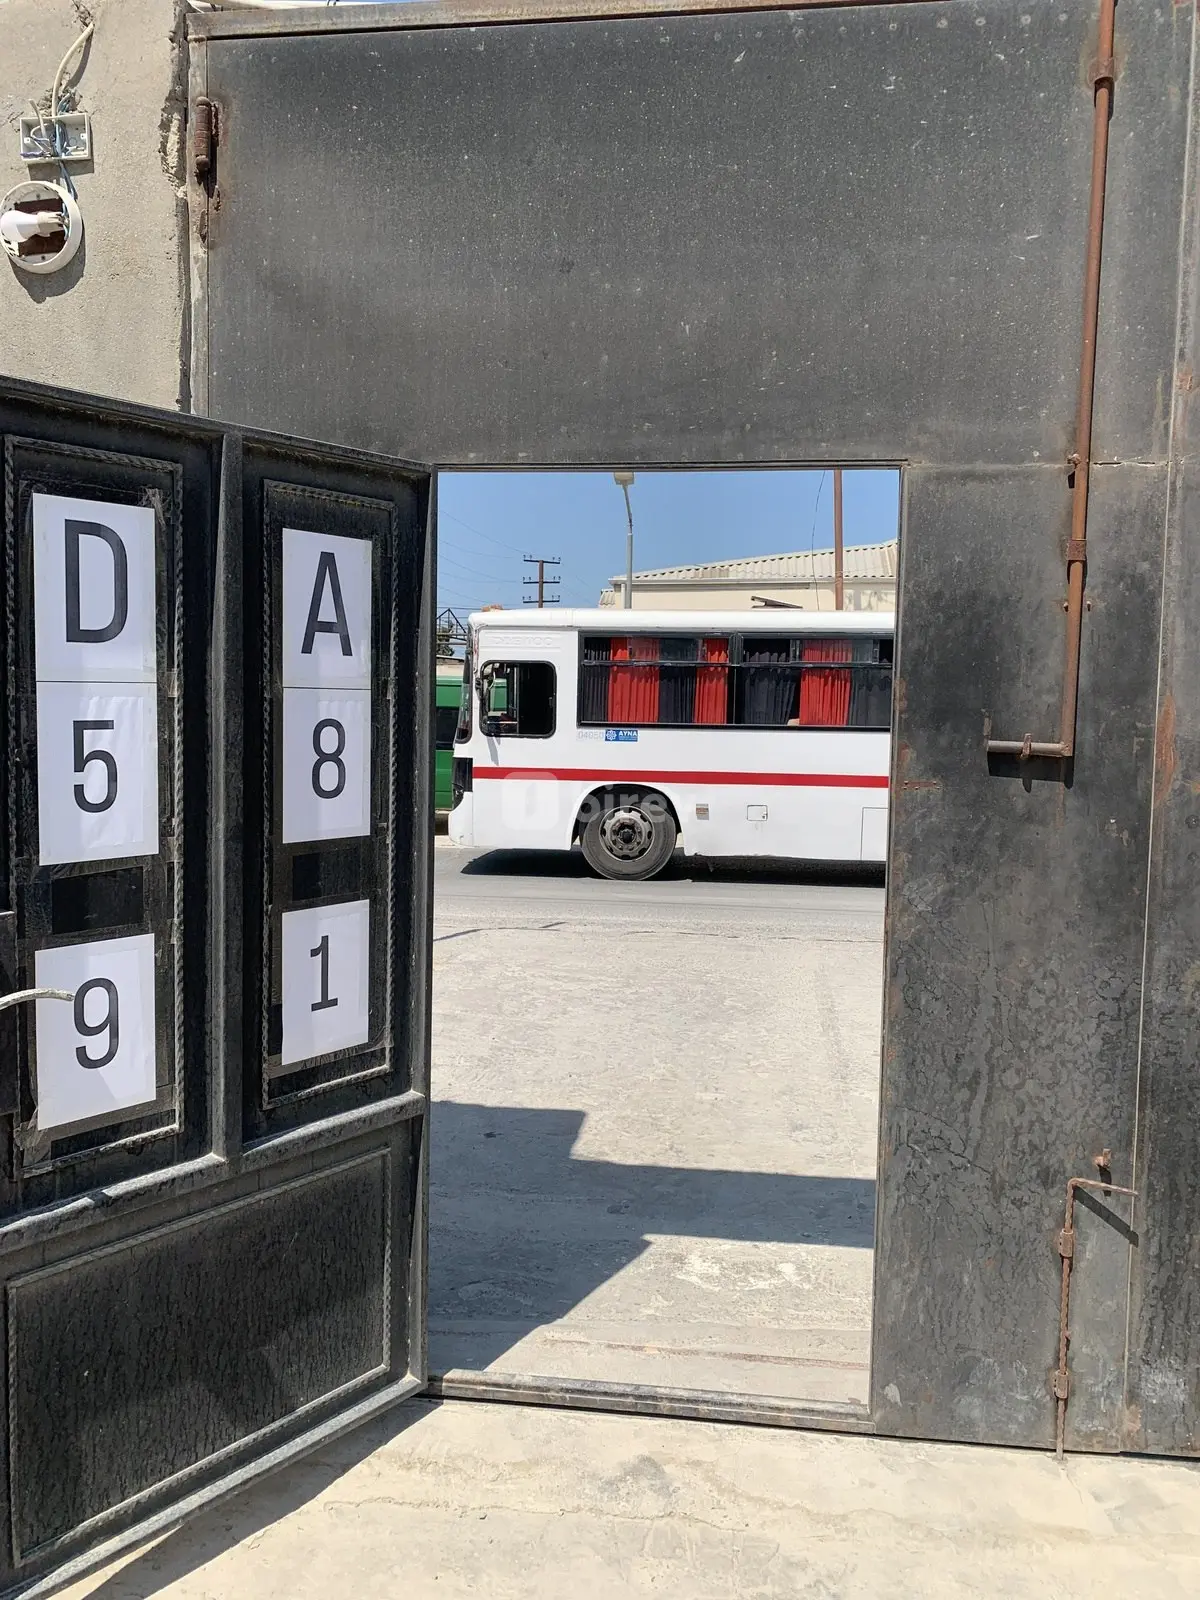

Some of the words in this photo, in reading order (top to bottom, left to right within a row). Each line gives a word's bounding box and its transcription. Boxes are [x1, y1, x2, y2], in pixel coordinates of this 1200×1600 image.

[64, 518, 129, 644] D
[300, 550, 354, 657] A
[72, 719, 119, 814] 5
[311, 718, 346, 800] 8
[309, 934, 339, 1012] 1
[73, 977, 120, 1070] 9
